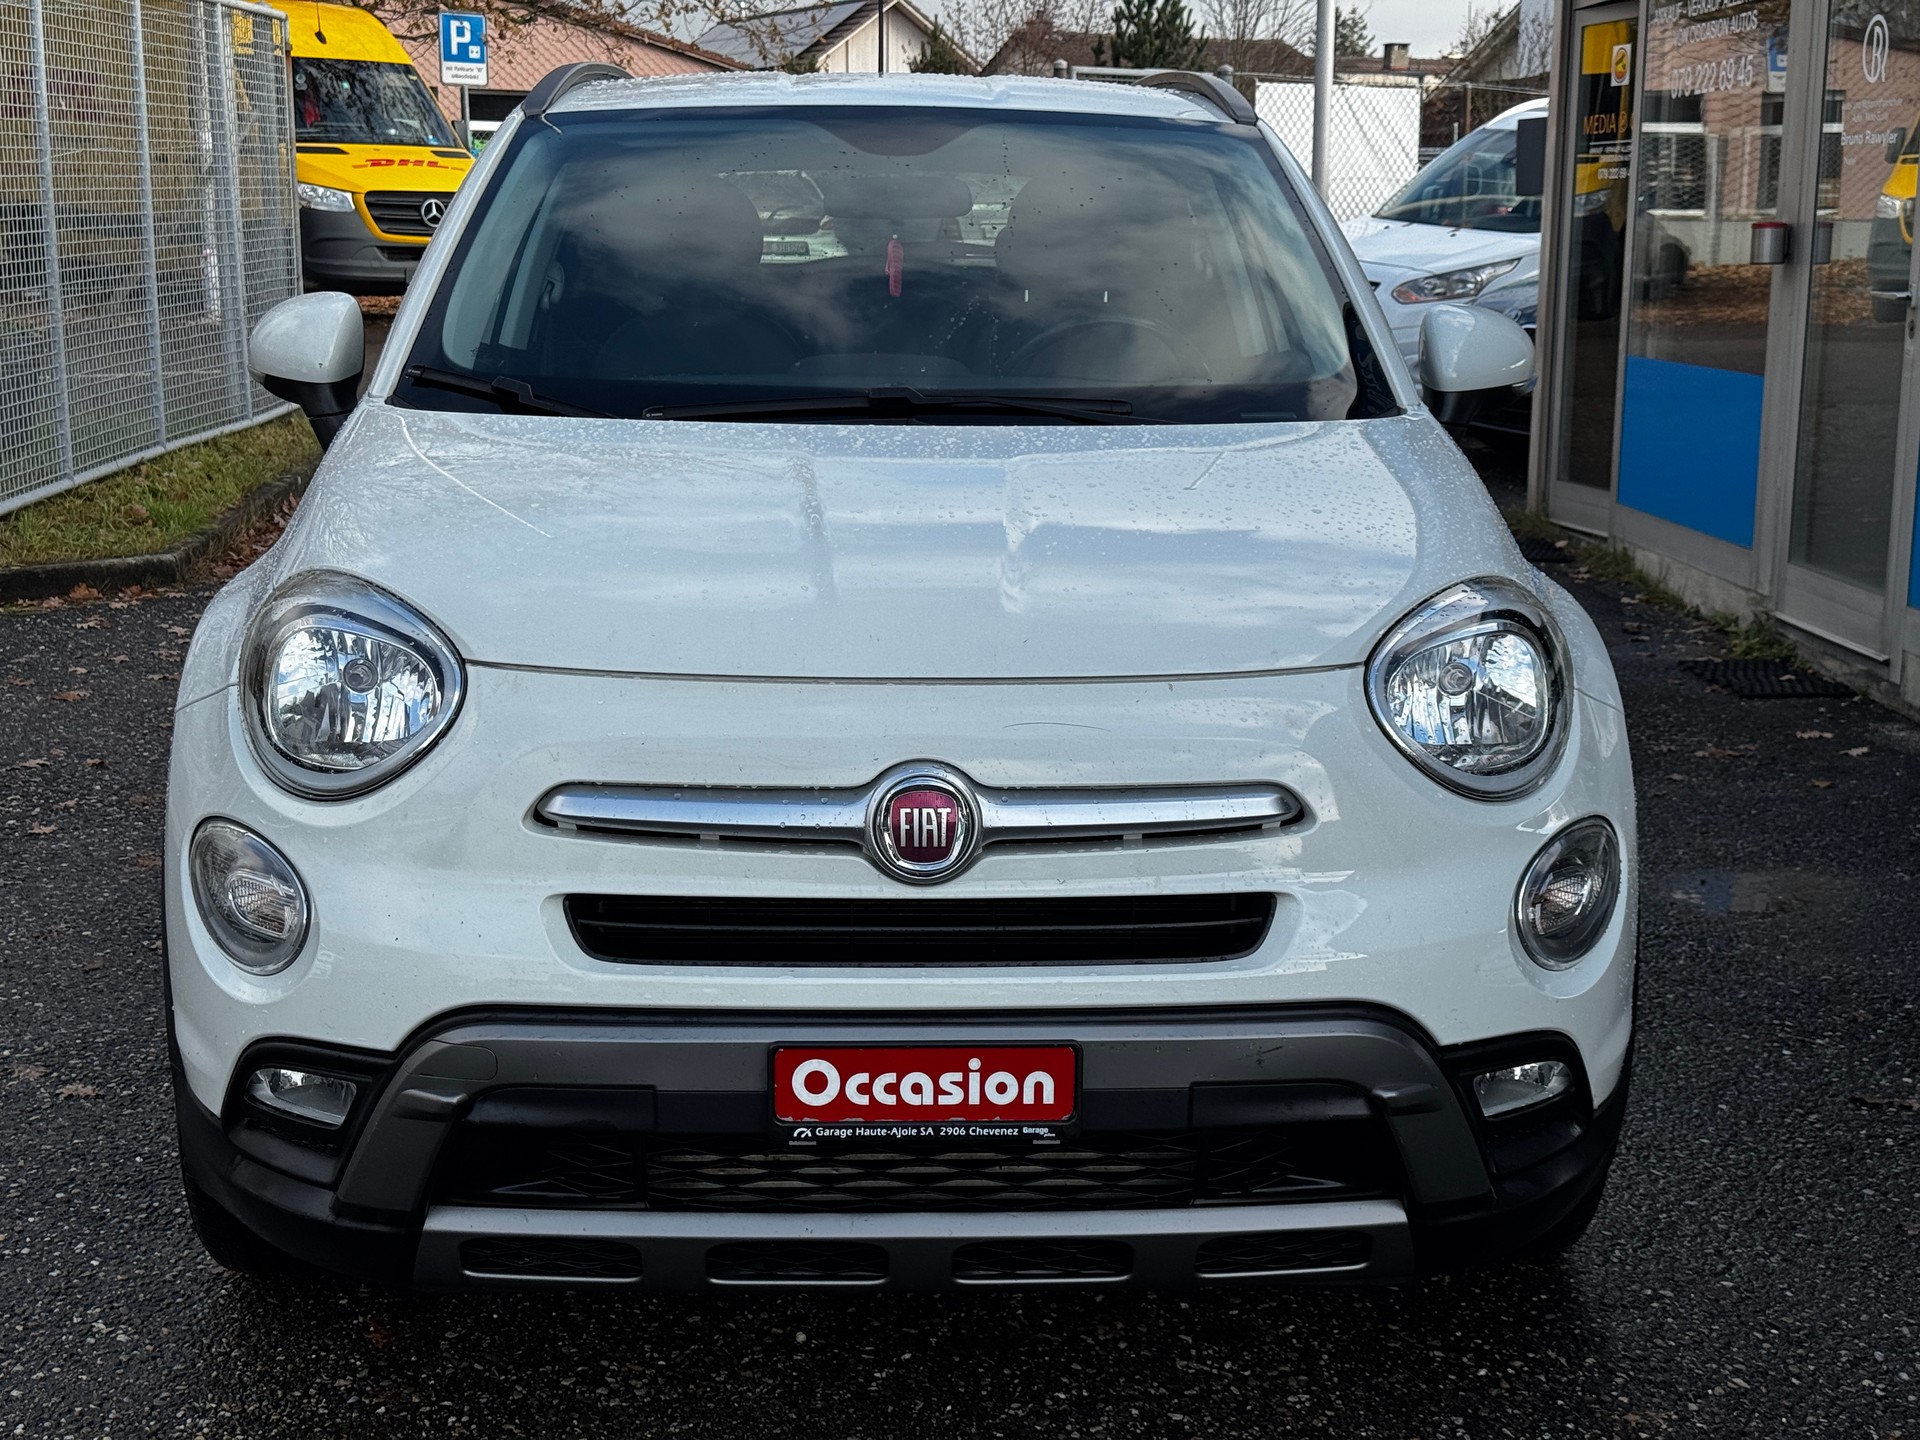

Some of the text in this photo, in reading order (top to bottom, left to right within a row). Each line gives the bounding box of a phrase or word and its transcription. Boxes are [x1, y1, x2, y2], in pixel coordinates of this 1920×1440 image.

[1729, 9, 1758, 34] AUTOS
[450, 20, 471, 55] P
[1671, 55, 1754, 99] 079 222 69 45
[1583, 113, 1616, 135] MEDIA
[365, 159, 450, 169] DHL
[900, 808, 951, 848] FIAT
[792, 1057, 1055, 1107] Occasion
[815, 1127, 853, 1138] Garage
[920, 1127, 934, 1136] SA
[939, 1127, 966, 1136] 2906
[969, 1126, 1019, 1136] Chevenez
[1022, 1126, 1049, 1135] Garage
